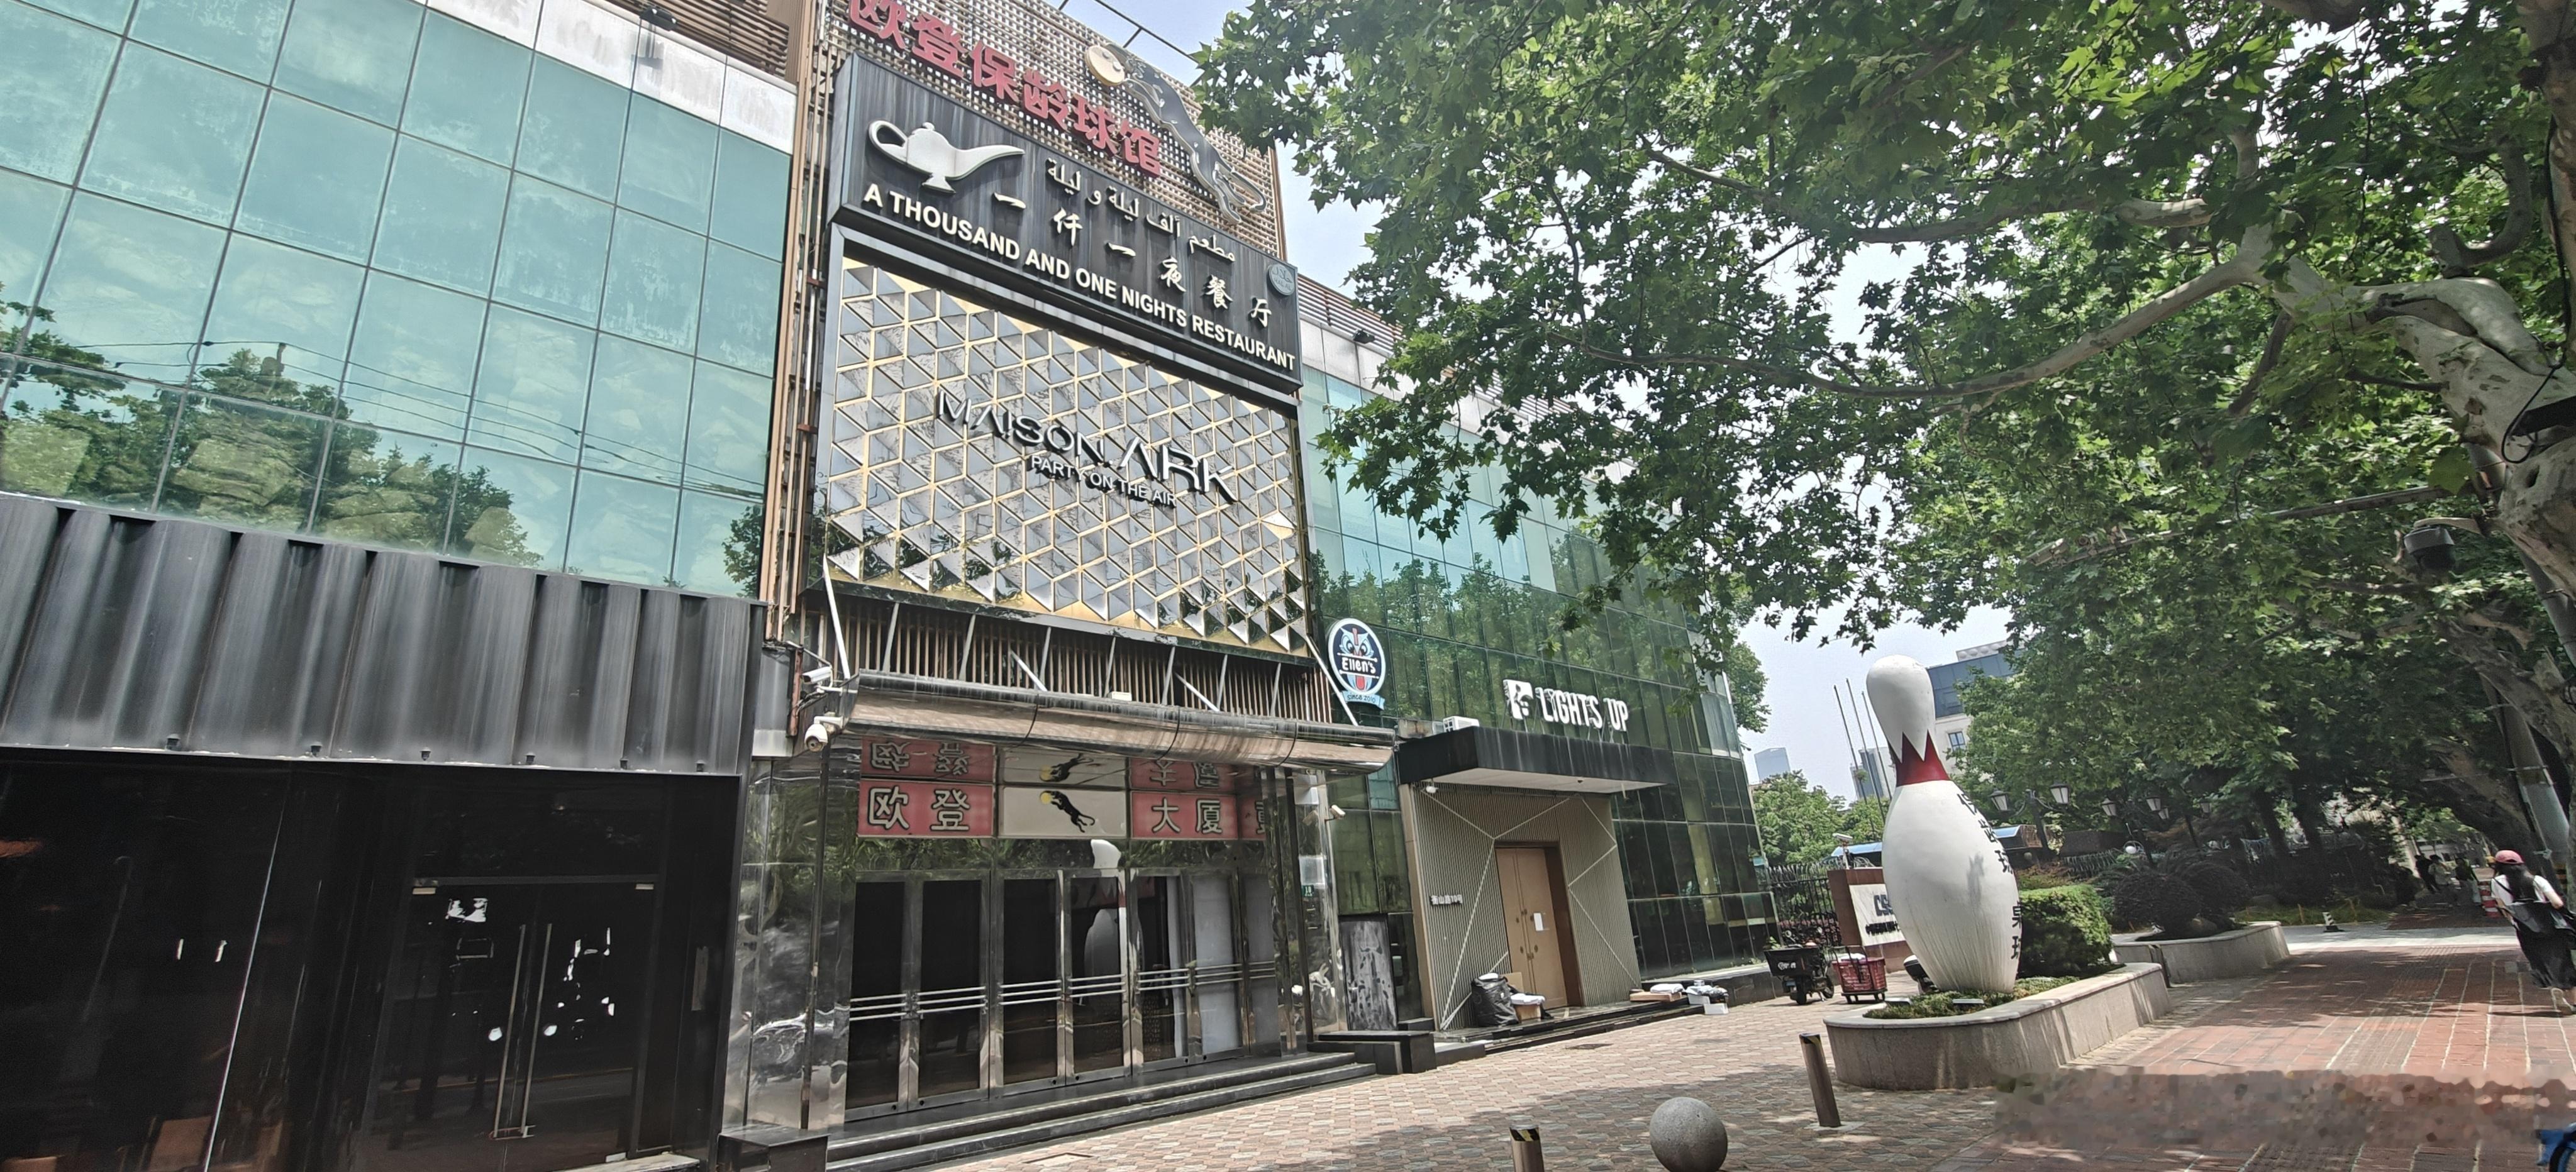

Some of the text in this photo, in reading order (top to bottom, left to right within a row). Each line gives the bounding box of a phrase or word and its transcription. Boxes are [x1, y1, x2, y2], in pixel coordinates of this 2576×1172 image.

[850, 0, 1162, 179] 欧登保龄球馆
[1046, 157, 1236, 263] مطعم ألف ليلة و ليلة
[864, 184, 1296, 370] A THOUSAND AND ONE NIGHTS RESTAURANT
[937, 389, 1238, 502] MAISON ARK
[1030, 455, 1177, 507] PARTY ON THE AIR
[1341, 657, 1376, 674] Ellen's
[1535, 687, 1629, 731] LIGHTS UP
[868, 785, 971, 831] 欧登
[1151, 797, 1223, 834] 大厦
